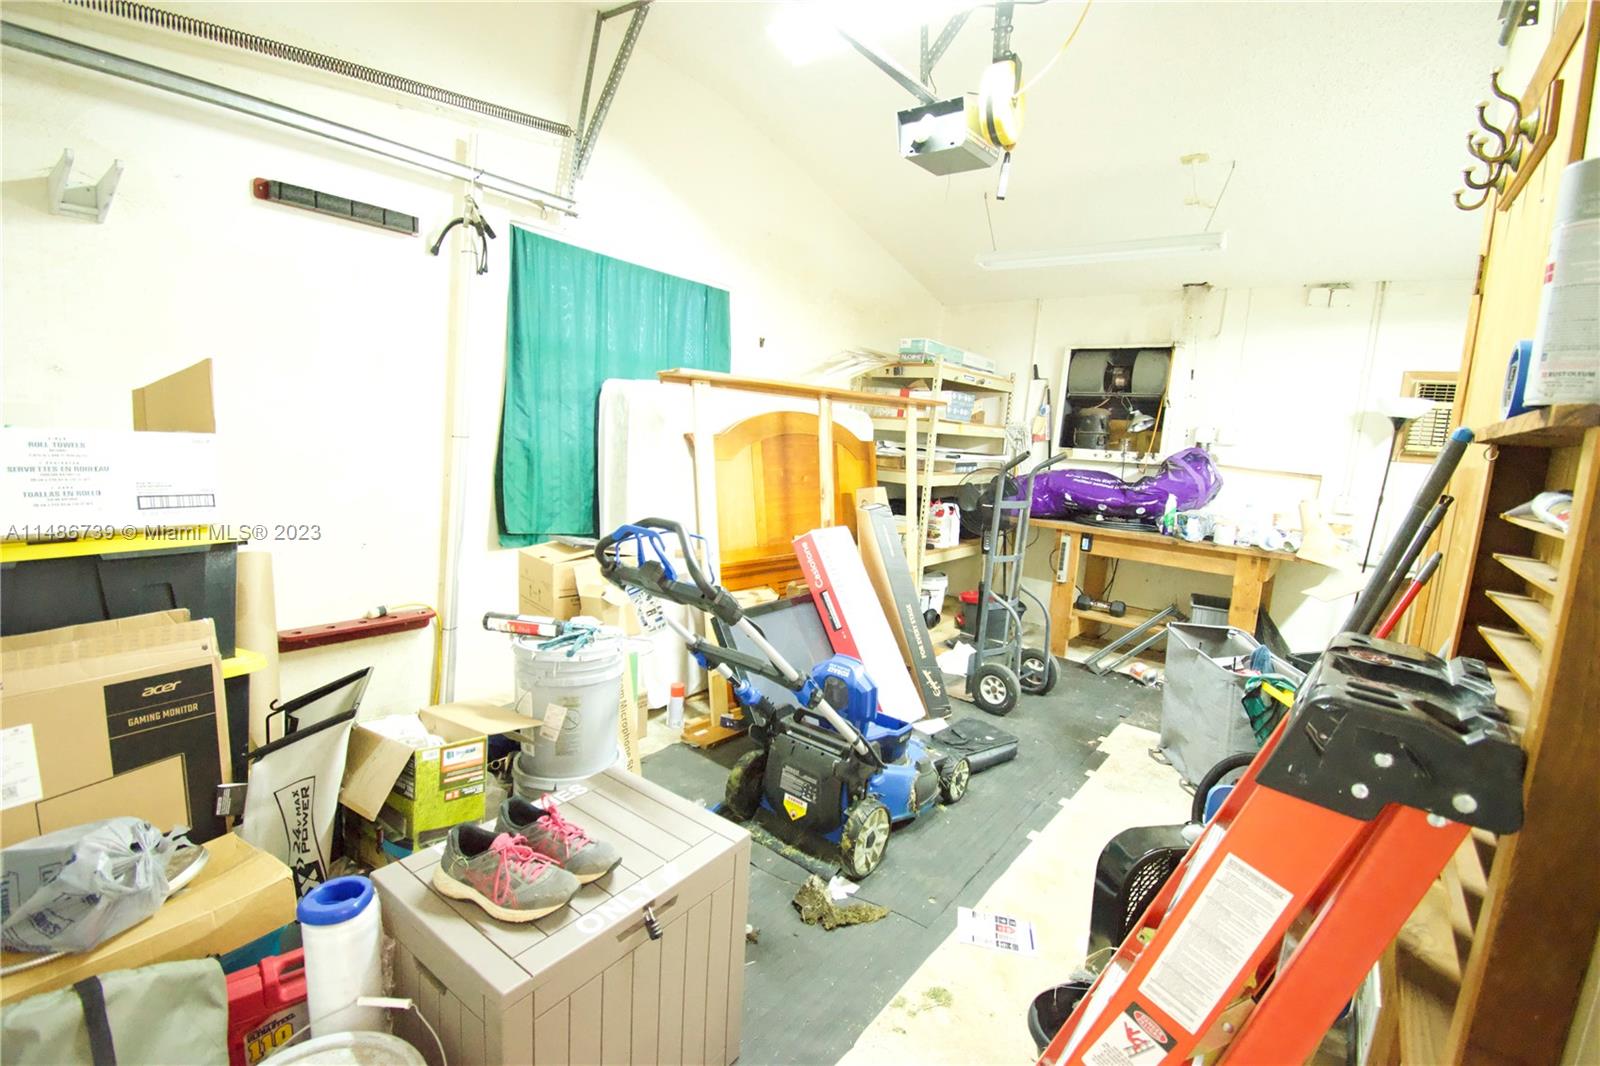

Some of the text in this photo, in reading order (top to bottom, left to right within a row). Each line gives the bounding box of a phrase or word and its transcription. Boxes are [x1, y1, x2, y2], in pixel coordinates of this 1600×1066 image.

[27, 441, 86, 449] ROLL TOWELS
[7, 465, 58, 473] SERVIETTES
[60, 465, 72, 473] EN
[22, 490, 61, 499] TOALLAS
[76, 489, 102, 497] ROLLO
[802, 541, 824, 589] Casiotone
[141, 680, 182, 697] acer
[127, 703, 199, 728] GAMING MONITOR
[620, 699, 632, 758] Microphone
[291, 790, 301, 819] MAX
[301, 785, 311, 855] POWER
[575, 884, 656, 934] ONLY
[248, 1022, 294, 1064] 110
